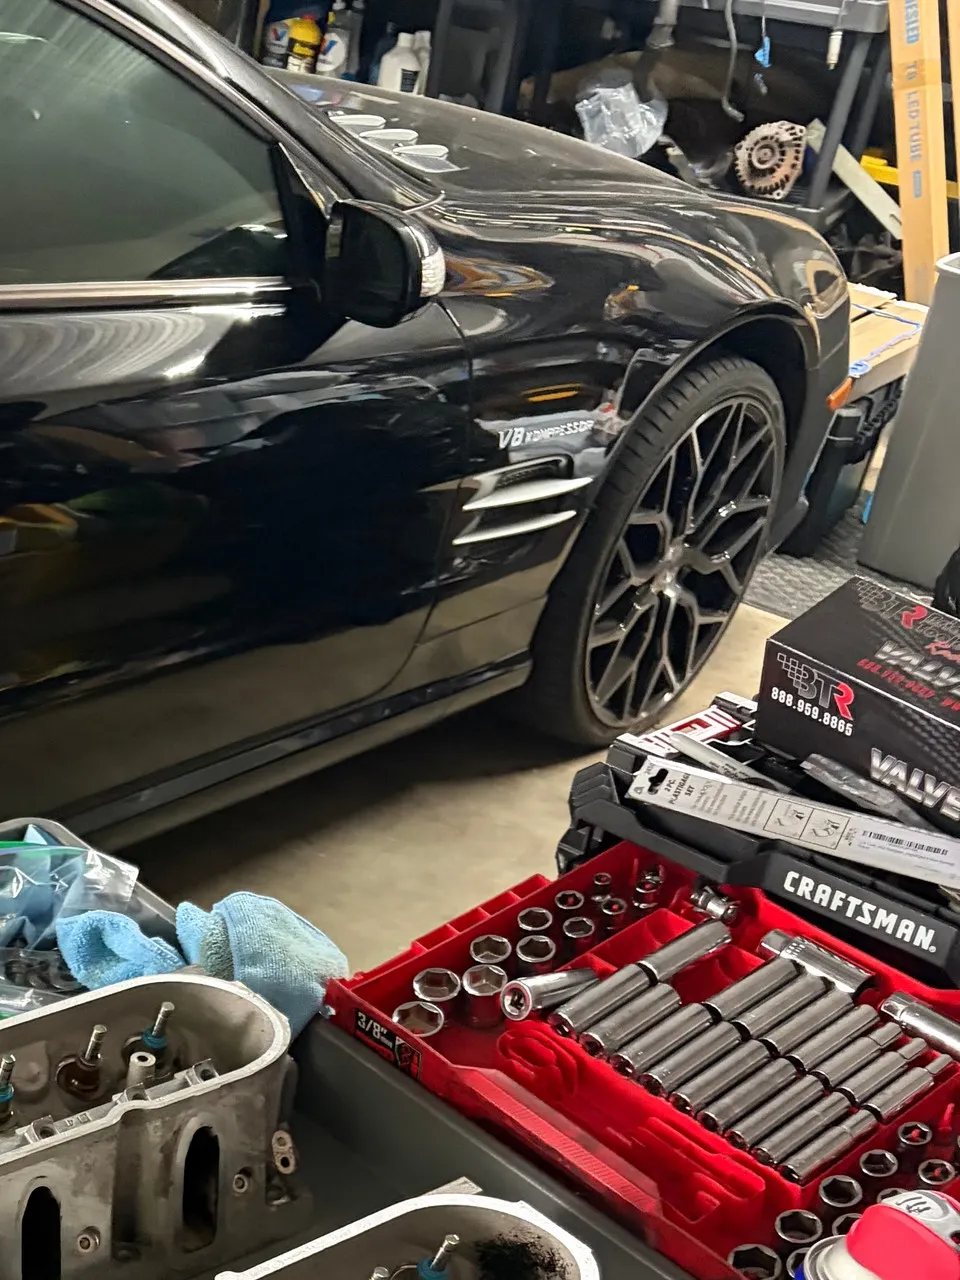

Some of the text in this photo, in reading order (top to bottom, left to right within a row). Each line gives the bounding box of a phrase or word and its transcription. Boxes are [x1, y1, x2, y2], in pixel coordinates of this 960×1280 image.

[907, 91, 920, 121] LED
[498, 427, 526, 449] V8
[771, 686, 854, 737] 888.959.8865
[785, 656, 854, 721] BTR
[784, 869, 937, 952] CRAFTSMAN
